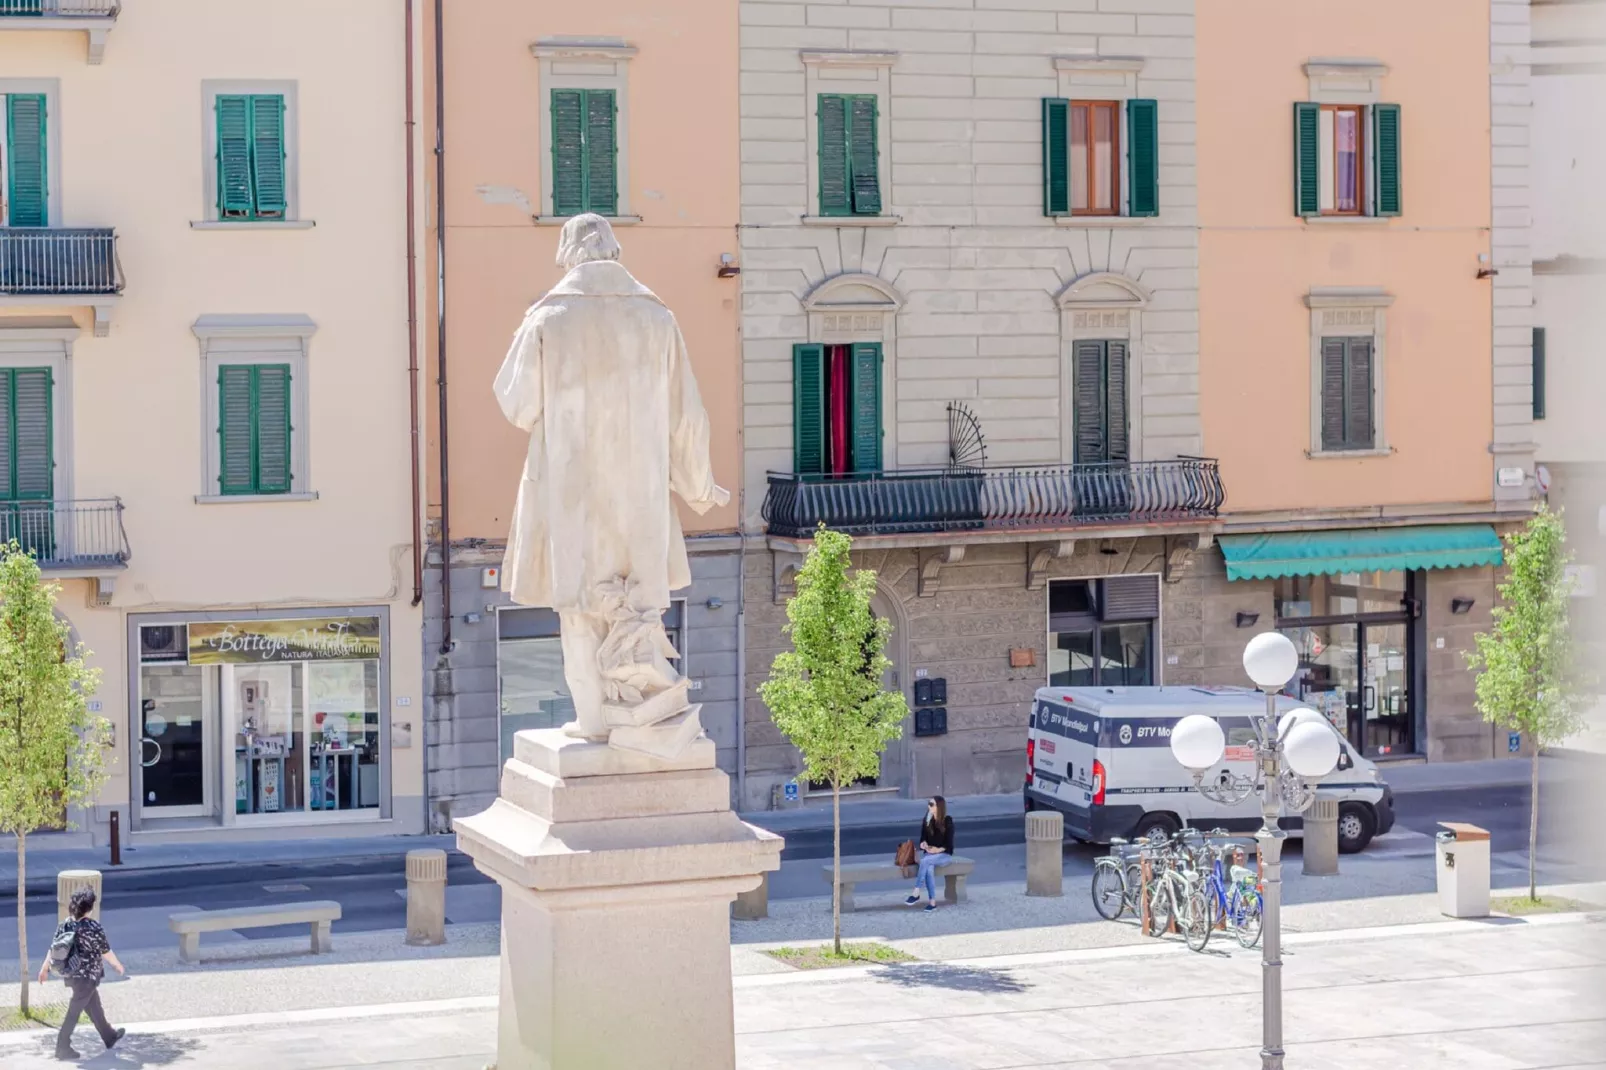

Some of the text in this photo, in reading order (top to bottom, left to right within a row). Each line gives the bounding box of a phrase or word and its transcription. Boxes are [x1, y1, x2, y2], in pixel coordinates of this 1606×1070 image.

[209, 624, 288, 660] Bottega
[281, 649, 350, 659] NATURA ITALIANA
[1050, 713, 1063, 724] BTV
[1137, 726, 1156, 737] BTV
